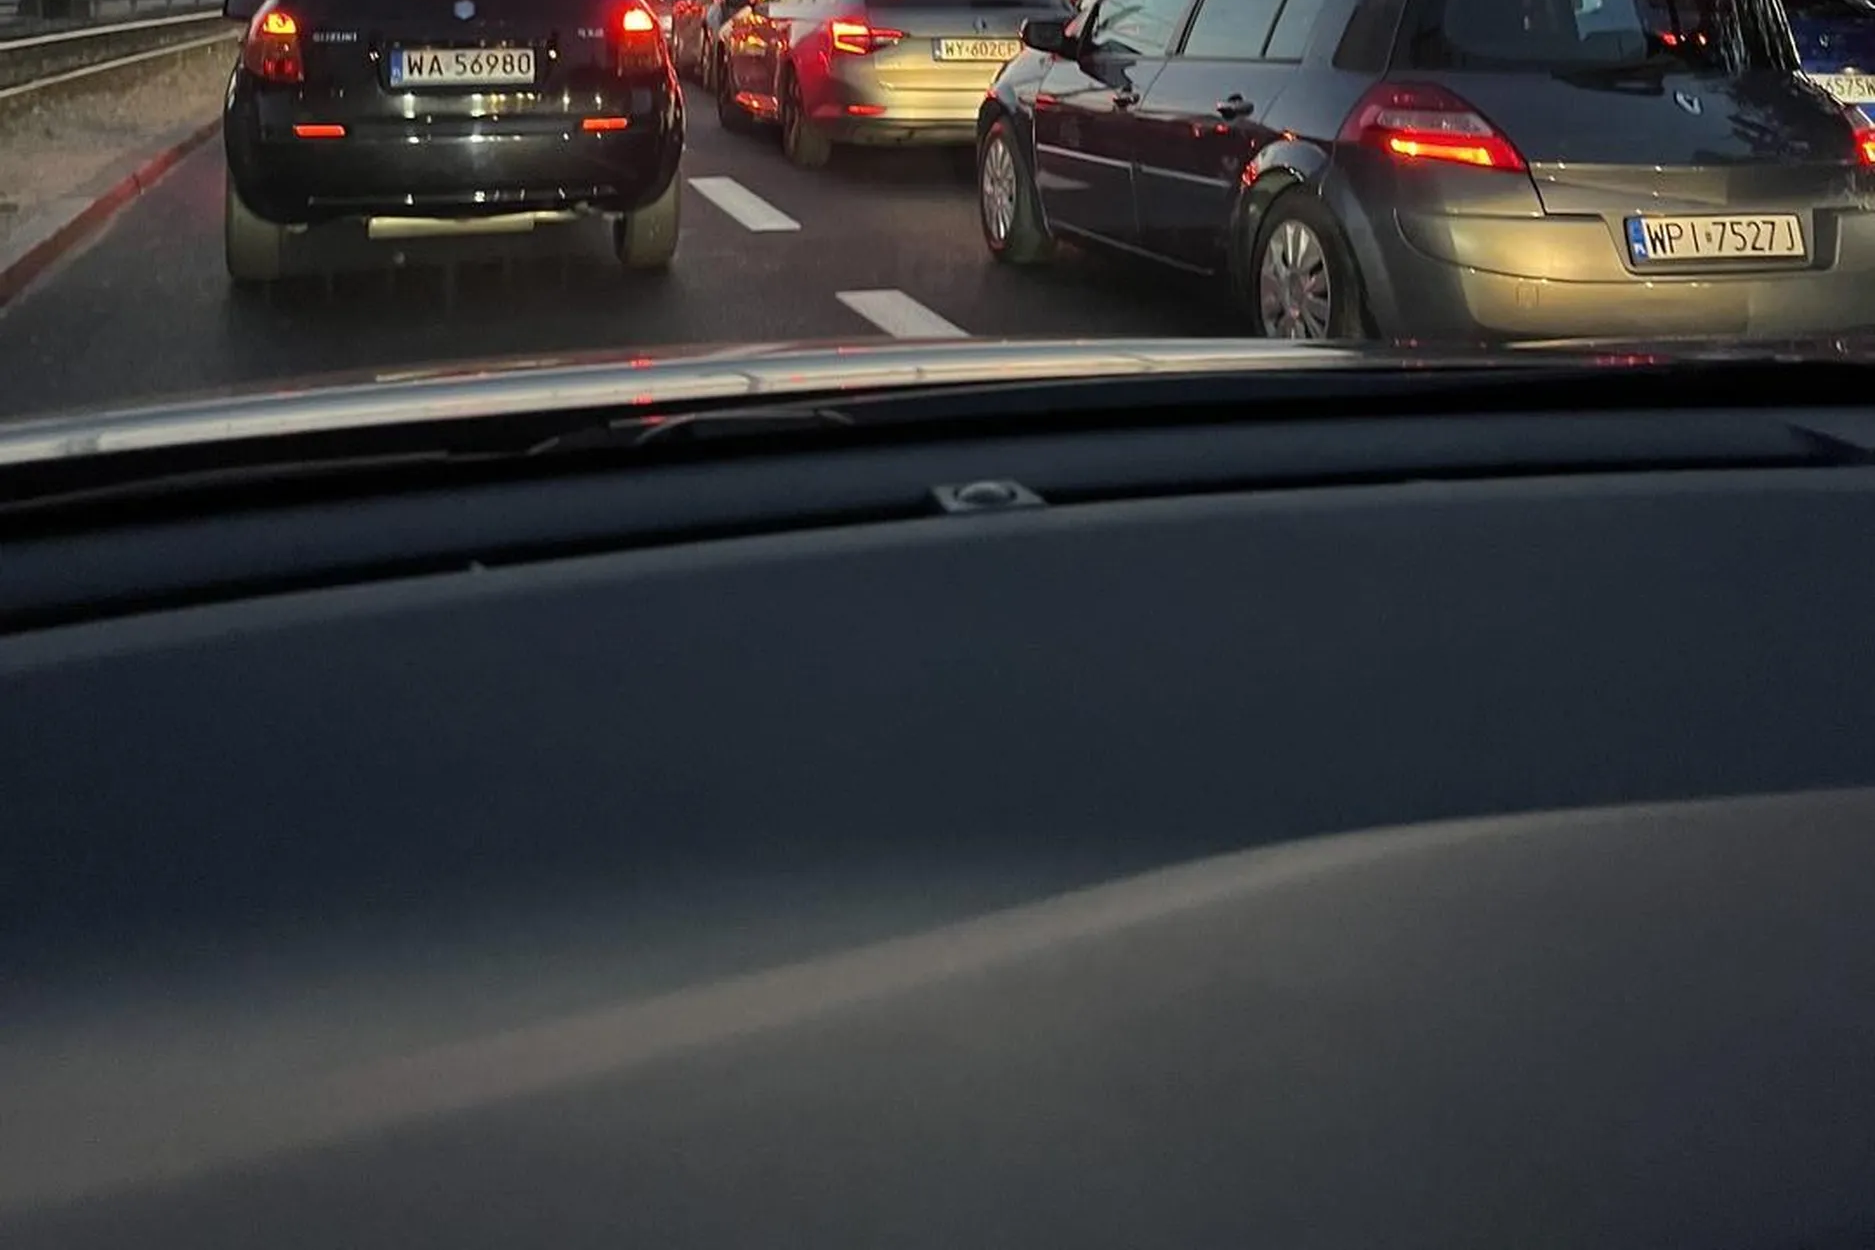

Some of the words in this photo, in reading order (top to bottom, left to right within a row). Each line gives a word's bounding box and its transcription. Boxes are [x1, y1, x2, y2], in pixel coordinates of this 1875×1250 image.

[944, 40, 964, 57] WY
[407, 54, 443, 76] WA
[455, 53, 531, 75] 56980
[1646, 222, 1700, 255] WPI
[1712, 220, 1796, 252] 7527J
